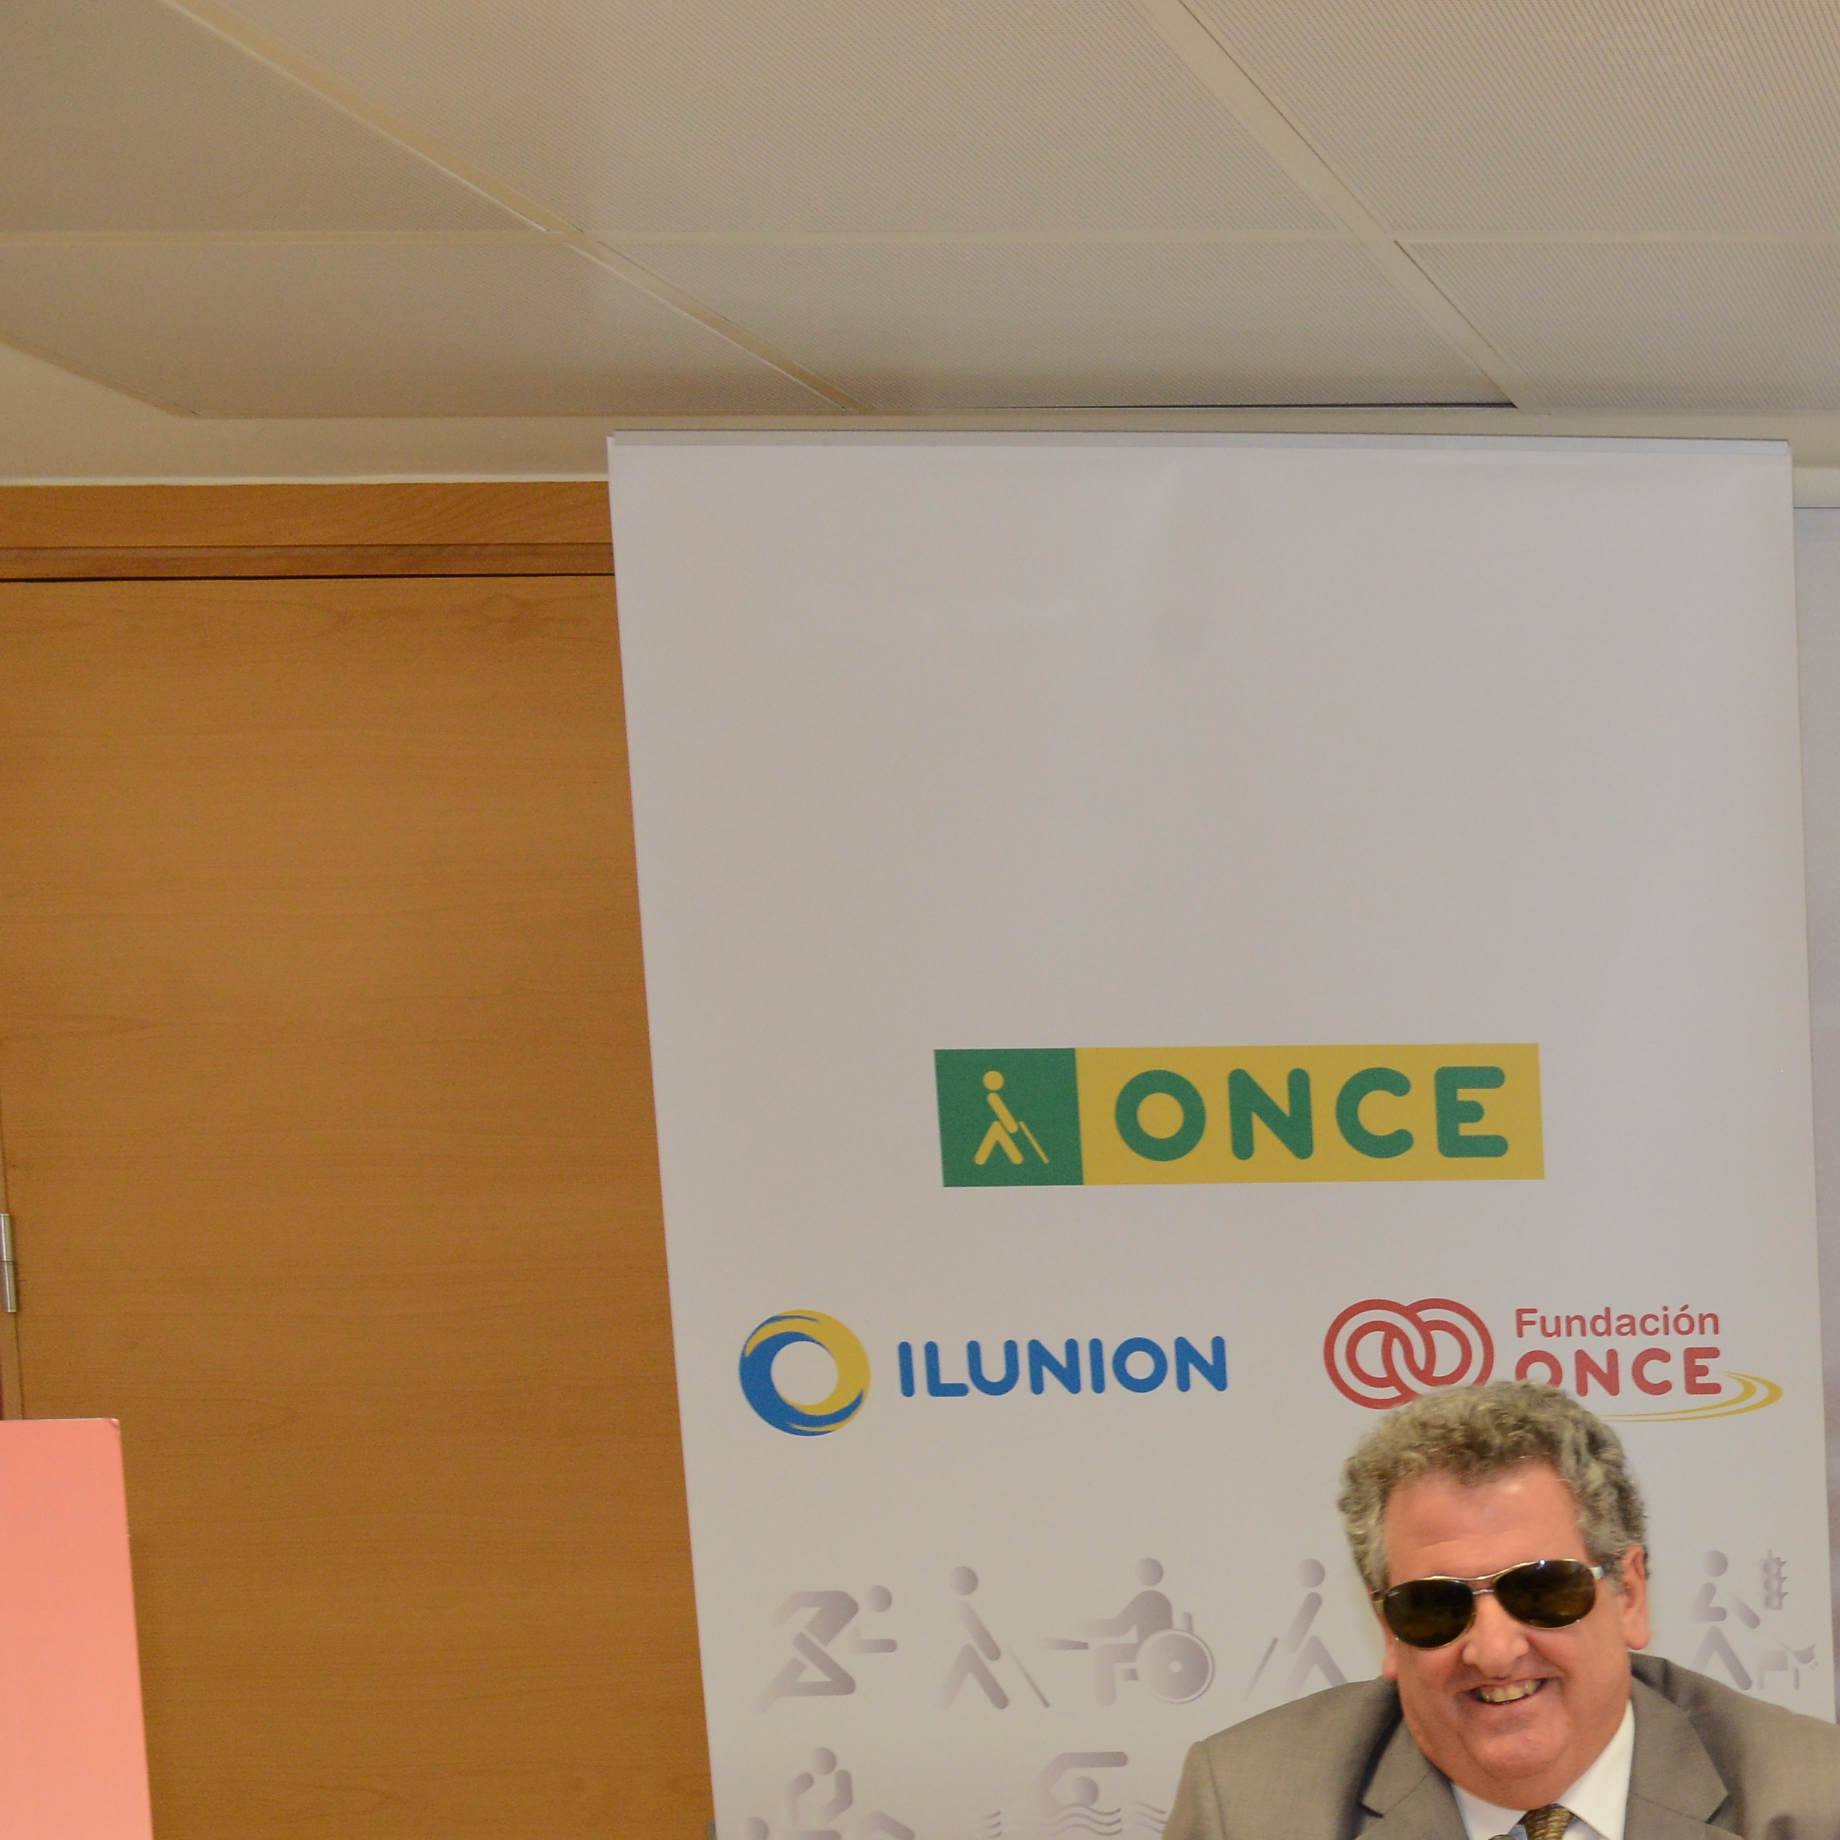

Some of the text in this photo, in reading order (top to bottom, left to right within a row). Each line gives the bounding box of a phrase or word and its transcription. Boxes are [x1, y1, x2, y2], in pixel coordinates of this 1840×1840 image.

[1114, 1065, 1510, 1162] ONCE
[1515, 1303, 1720, 1339] Fundación
[897, 1335, 1229, 1398] ILUNION
[1515, 1346, 1722, 1397] ONCE
